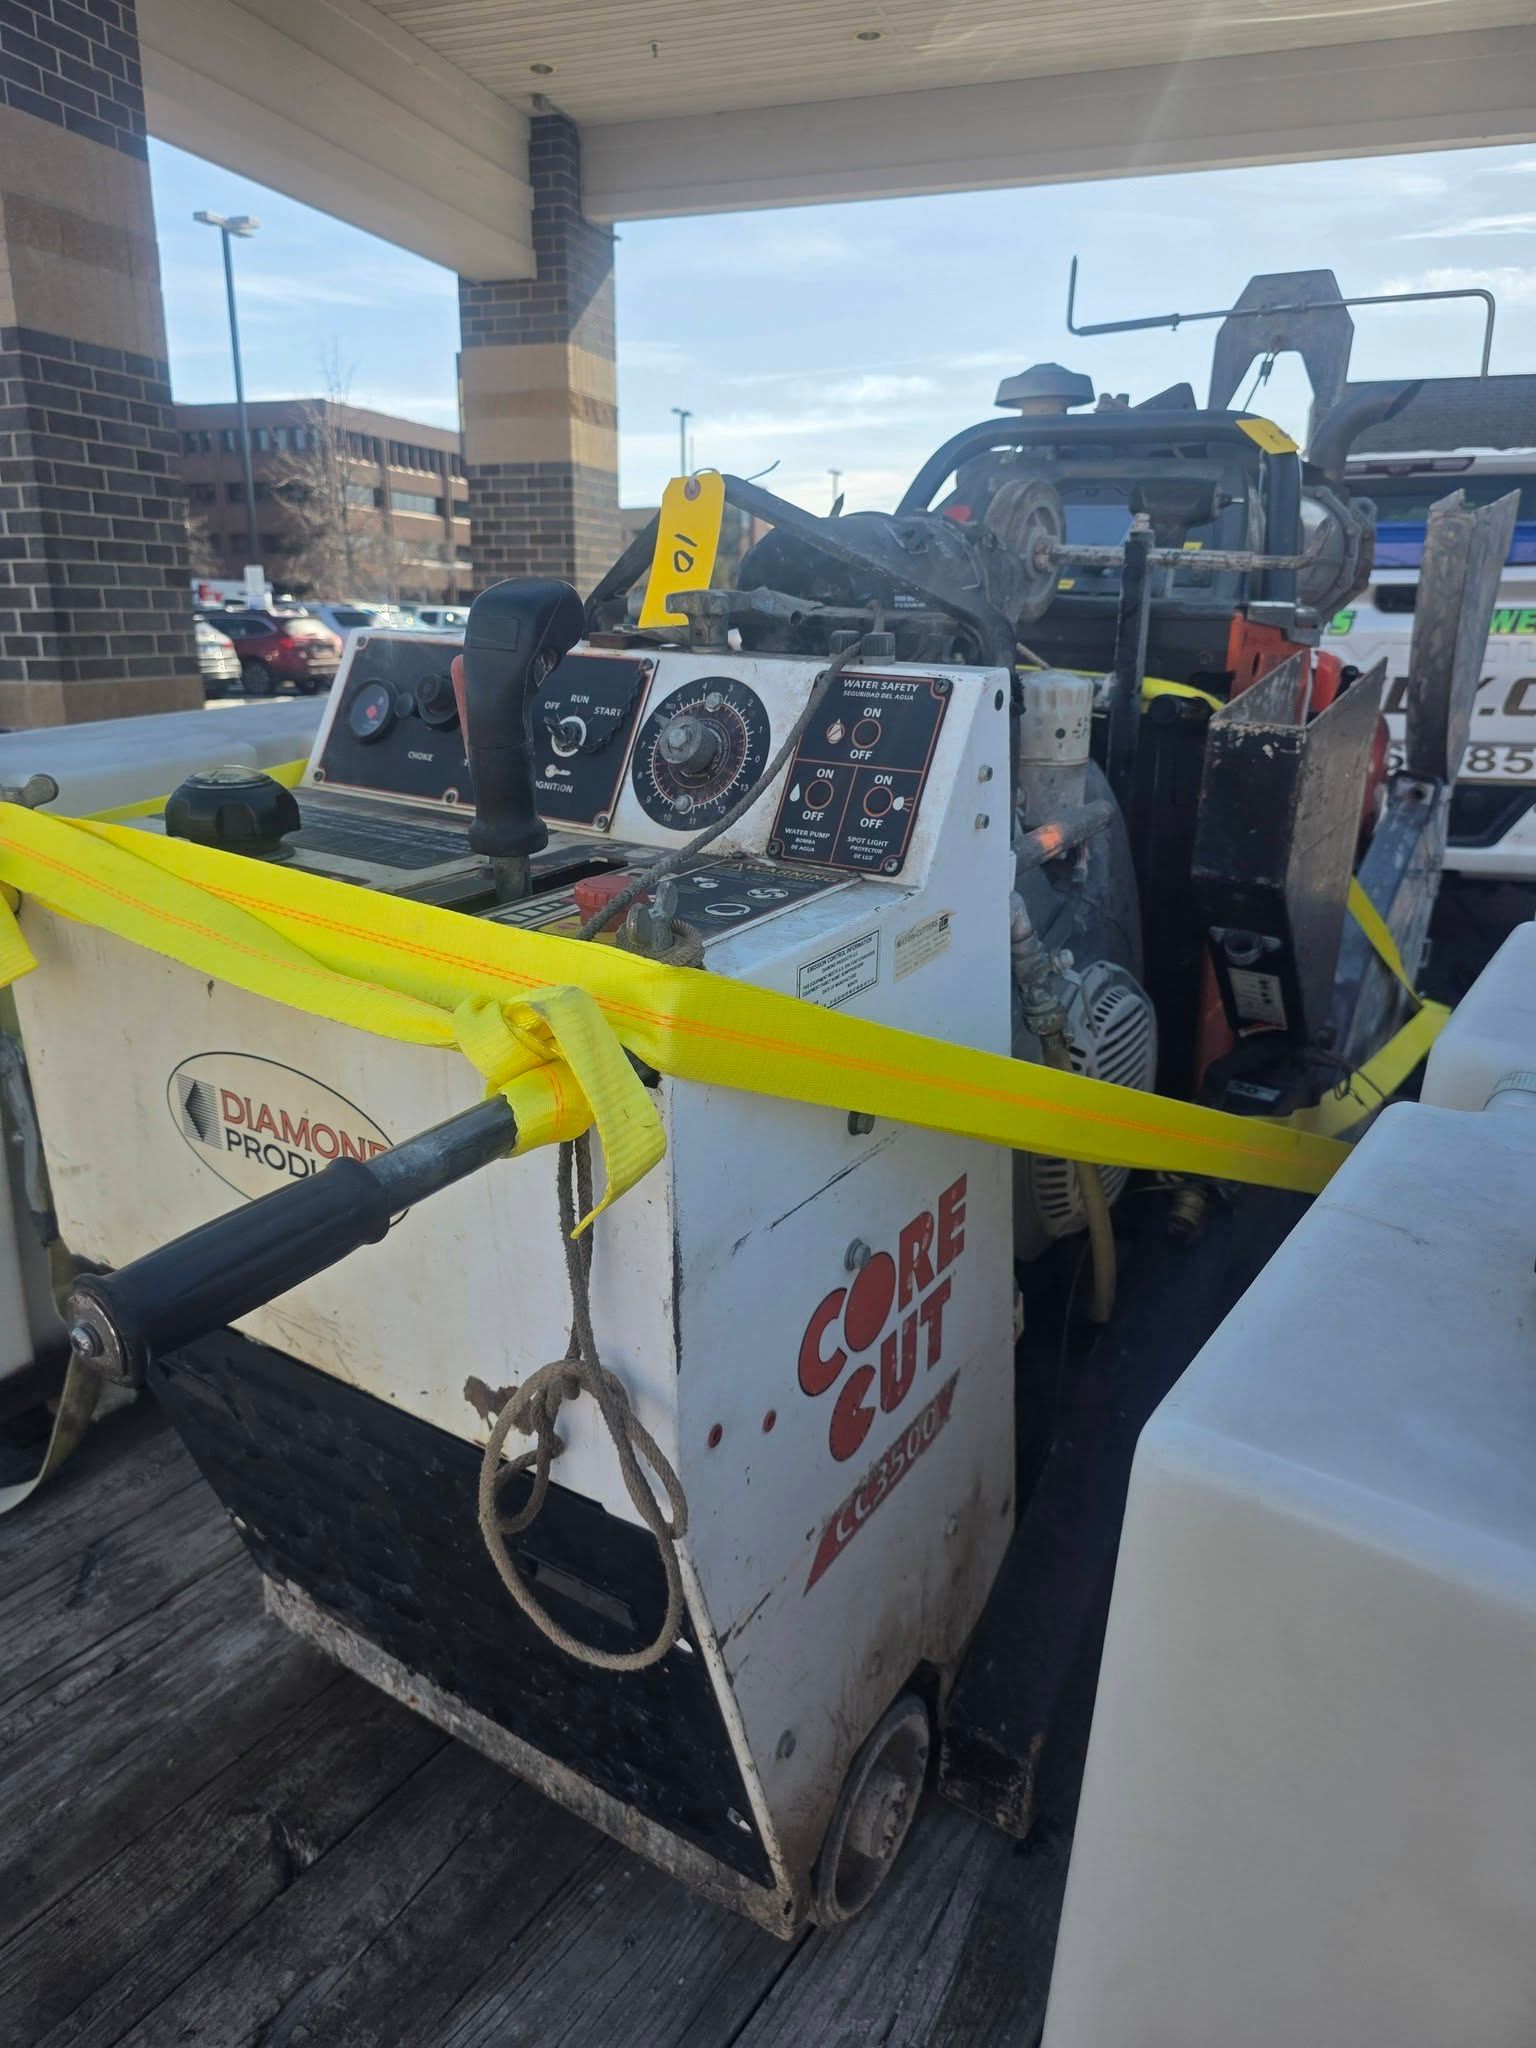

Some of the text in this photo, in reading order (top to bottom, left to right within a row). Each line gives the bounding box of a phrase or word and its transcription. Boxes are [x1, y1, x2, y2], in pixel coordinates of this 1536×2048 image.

[843, 679, 920, 693] WATER SAFETY
[570, 694, 590, 704] RUN
[842, 690, 880, 698] SEGURIDAD
[880, 692, 893, 700] DEL
[544, 701, 560, 711] OFF
[747, 699, 754, 707] 2
[593, 706, 621, 717] START
[863, 707, 881, 718] ON
[407, 750, 434, 762] CHOKE
[849, 749, 873, 760] OFF
[816, 768, 834, 779] ON
[874, 774, 893, 786] ON
[535, 780, 574, 793] IGNITION
[740, 783, 749, 792] 13
[717, 805, 726, 814] 12
[802, 810, 825, 822] OFF
[860, 817, 883, 829] OFF
[784, 827, 831, 839] WATER PUMP
[795, 837, 816, 845] BOMBA
[847, 835, 889, 848] SPOT LIGHT
[746, 862, 841, 883] WARNING
[827, 949, 847, 966] CONTROL
[225, 1127, 316, 1179] PROD
[798, 1172, 968, 1397] CORE
[829, 1275, 952, 1462] CUT
